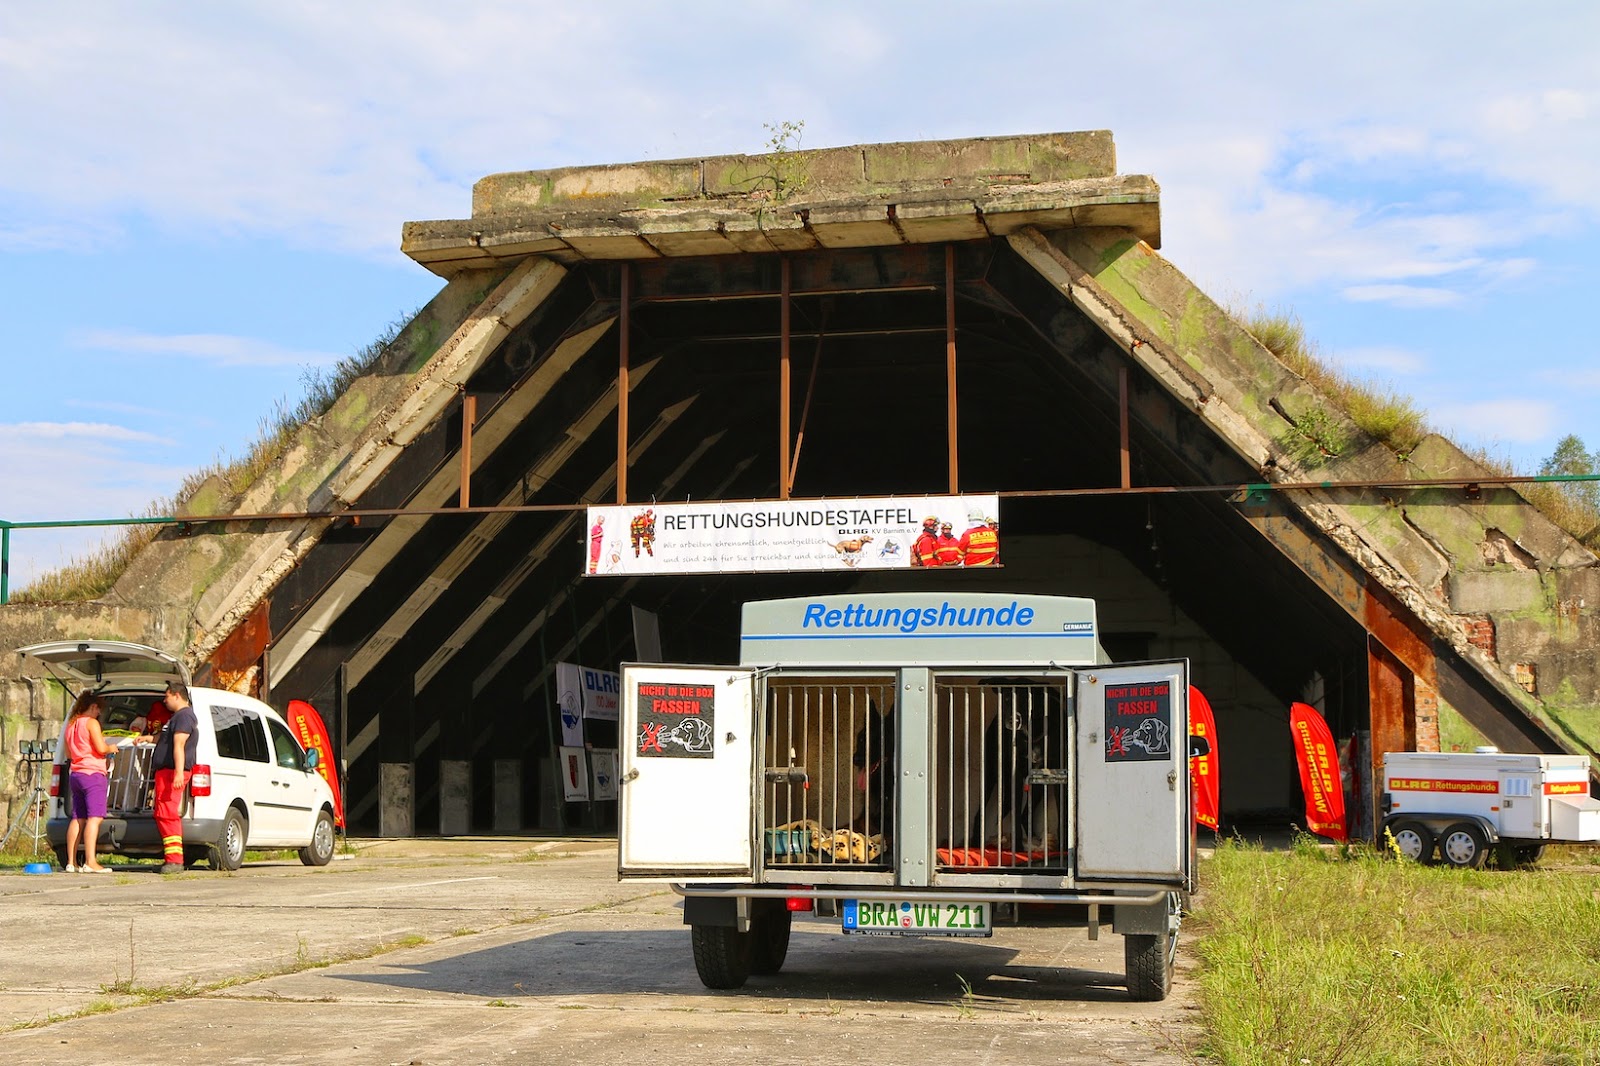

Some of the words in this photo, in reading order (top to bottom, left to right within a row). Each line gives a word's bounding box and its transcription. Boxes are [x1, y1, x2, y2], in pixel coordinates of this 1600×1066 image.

[664, 508, 918, 530] RETTUNGSHUNDESTAFFEL
[883, 527, 905, 535] Barnim
[906, 526, 918, 534] e.V.
[680, 540, 712, 548] arbeiten
[663, 555, 680, 563] und
[683, 554, 700, 562] sind
[751, 552, 791, 561] erreichbar
[794, 552, 811, 560] und
[803, 602, 1034, 633] Rettungshunde
[585, 671, 619, 693] DLRG
[640, 685, 666, 696] NICHT
[669, 686, 678, 697] IN
[680, 687, 694, 697] DIE
[696, 688, 713, 698] BOX
[1106, 688, 1128, 698] NICHT
[1130, 687, 1138, 697] IN
[1140, 686, 1152, 696] DIE
[1154, 685, 1169, 695] BOX
[652, 699, 701, 714] FASSEN
[1117, 701, 1158, 715] FASSEN
[1391, 780, 1430, 789] DLRG
[1436, 781, 1496, 791] Rettungshunde
[848, 916, 854, 924] D
[859, 902, 898, 926] BRA
[914, 903, 940, 928] VW
[946, 904, 985, 928] 211
